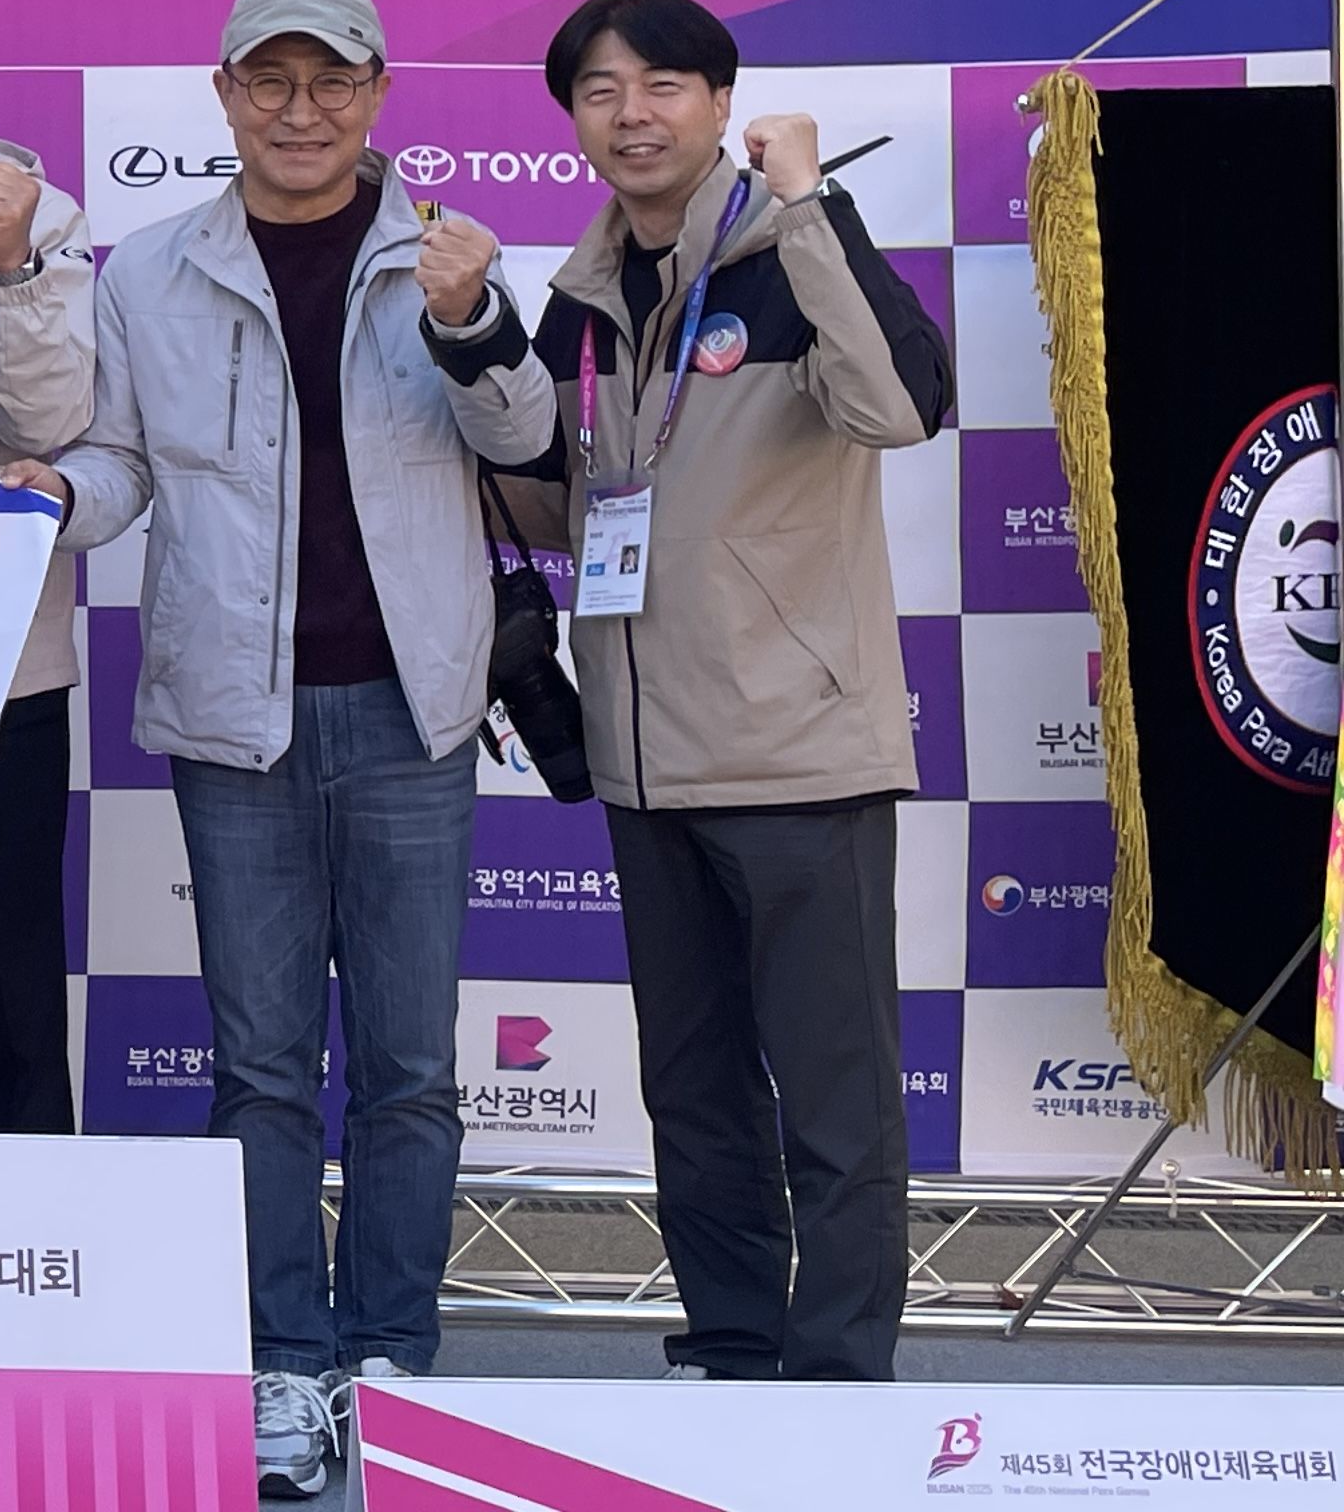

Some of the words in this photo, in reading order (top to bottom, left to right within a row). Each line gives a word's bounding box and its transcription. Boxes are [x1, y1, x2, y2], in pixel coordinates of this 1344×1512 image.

[1205, 623, 1244, 715] Korea
[1240, 706, 1293, 765] Para
[468, 867, 622, 900] 광역시교육청
[1000, 1452, 1074, 1477] 제45회
[1078, 1449, 1338, 1482] 전국장애인체육대회
